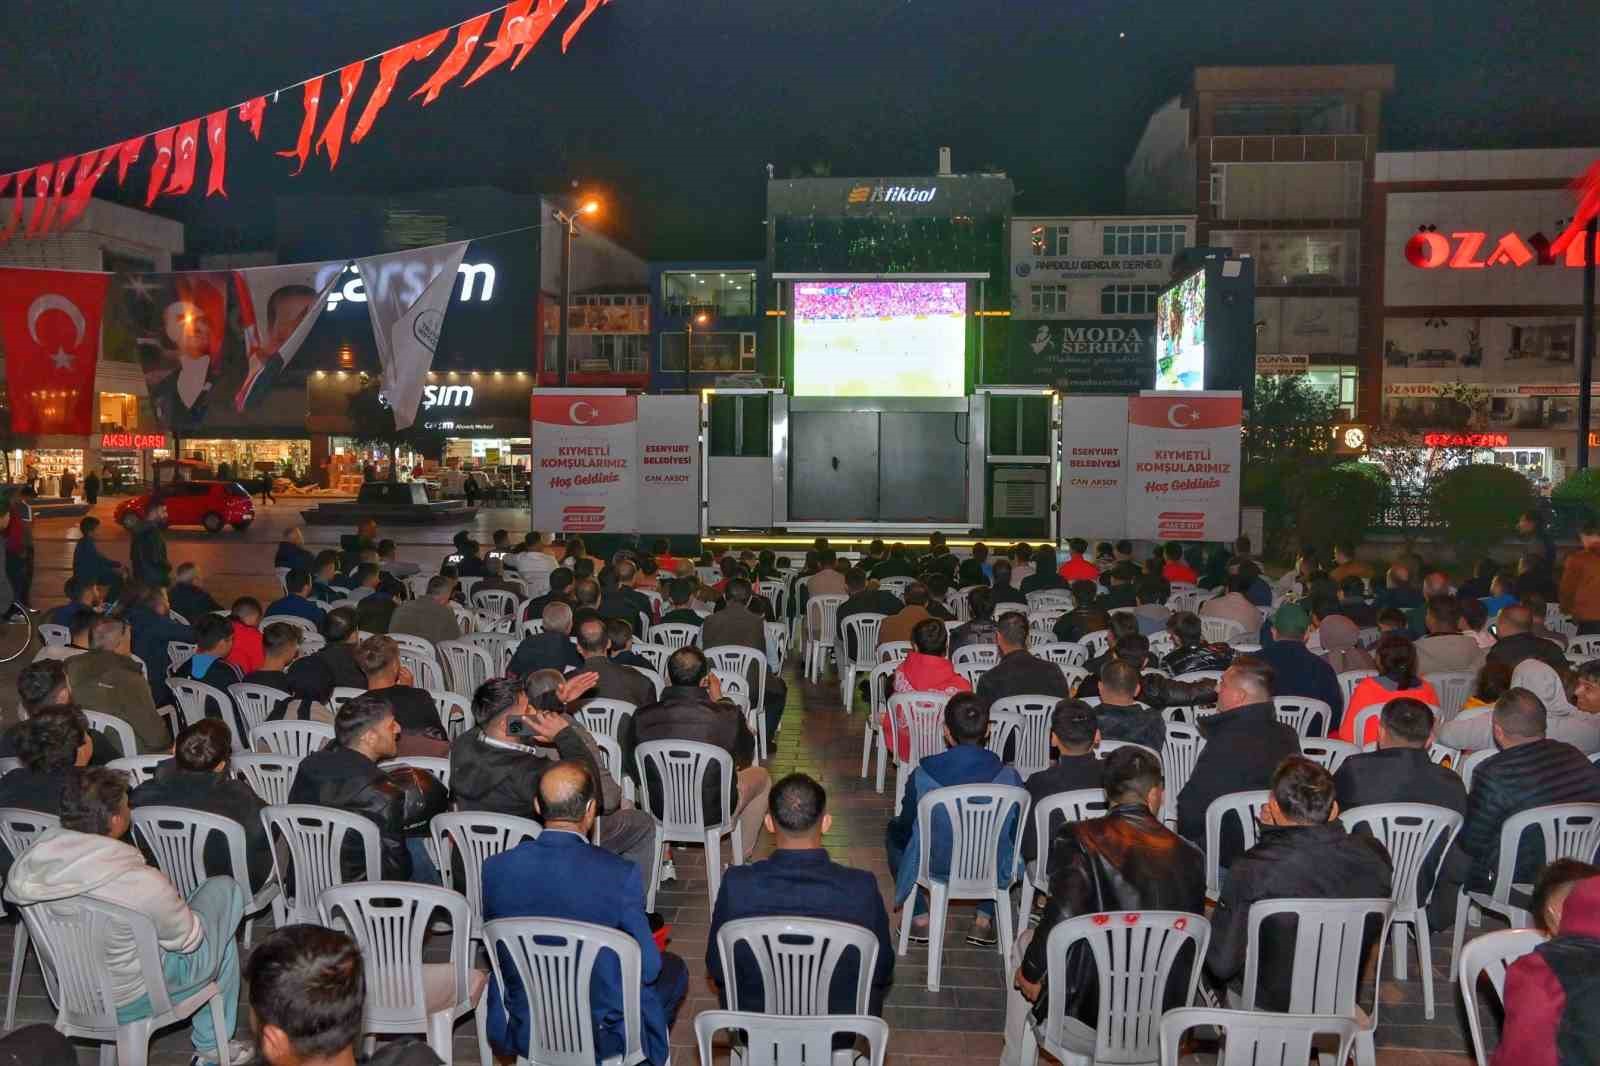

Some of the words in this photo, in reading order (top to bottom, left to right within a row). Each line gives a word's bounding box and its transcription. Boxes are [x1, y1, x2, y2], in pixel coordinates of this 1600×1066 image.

[1063, 327, 1144, 342] MODA
[1062, 342, 1144, 354] SERHAT
[558, 445, 610, 457] KIYMETLİ
[645, 445, 690, 454] ESENYURT
[1072, 447, 1120, 456] ESENYURT
[1155, 449, 1212, 461] KIYMETLİ
[541, 458, 627, 470] KOMŞULARIMIZ
[643, 455, 691, 465] BELEDİYESİ
[1070, 458, 1121, 468] BELEDİYESİ
[1136, 462, 1232, 475] KOMŞULARIMIZ
[550, 476, 572, 489] Hoş
[574, 472, 620, 487] Geldiniz
[1144, 480, 1169, 494] Hoş
[1170, 476, 1221, 491] Geldiniz
